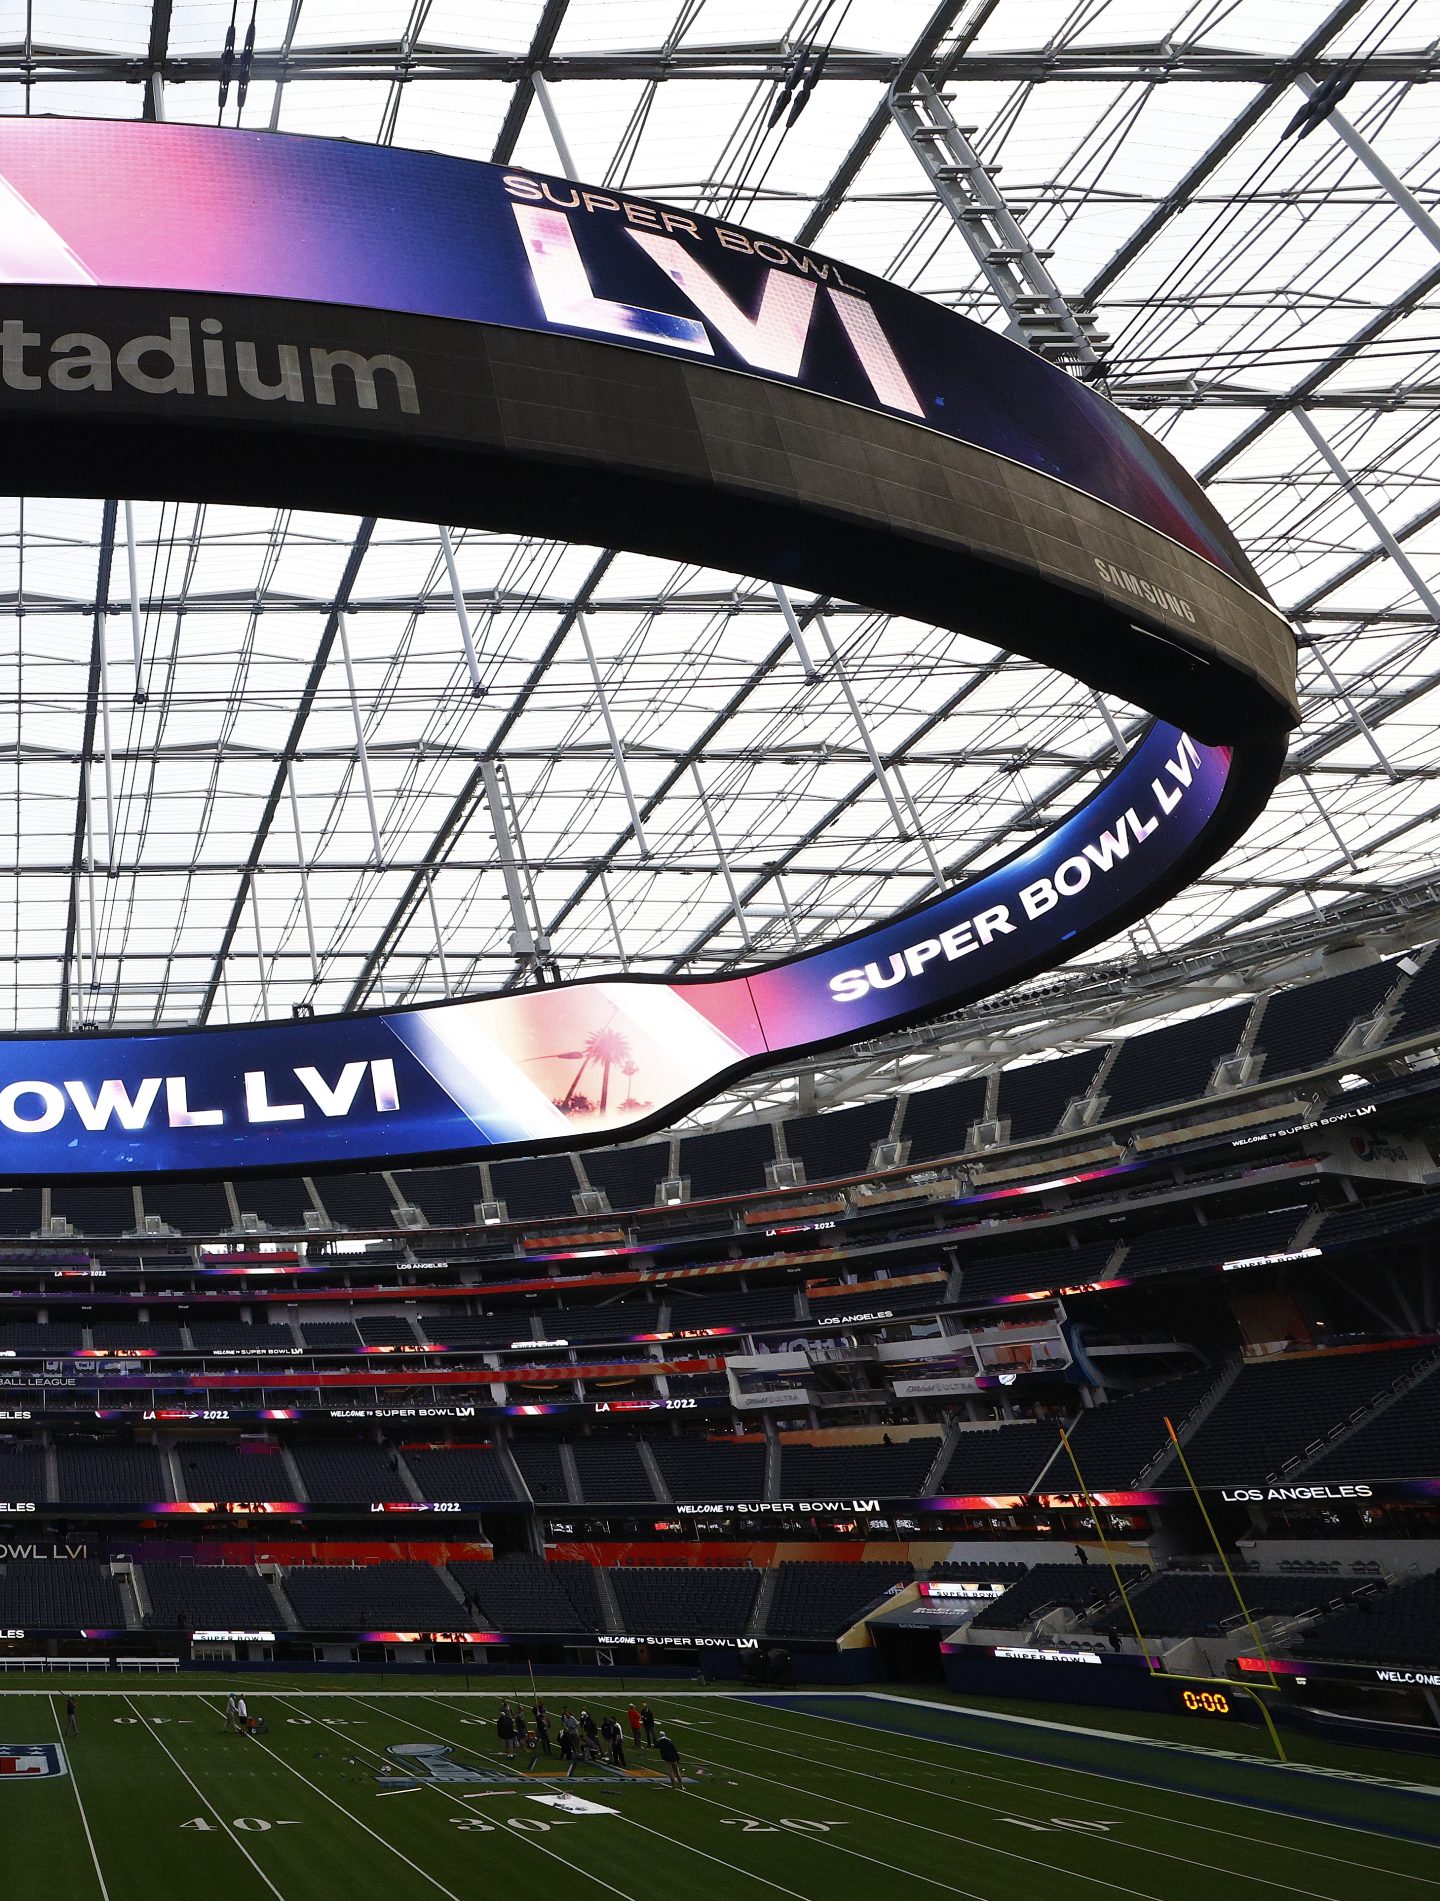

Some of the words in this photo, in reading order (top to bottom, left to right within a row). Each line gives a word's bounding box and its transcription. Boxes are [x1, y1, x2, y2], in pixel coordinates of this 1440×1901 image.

[503, 175, 703, 243] SUPER
[715, 229, 866, 295] BOWL
[512, 202, 926, 419] LVI
[1094, 557, 1196, 624] SAMSUNG
[829, 904, 1017, 1002] SUPER
[1019, 808, 1160, 920] BOWL
[1152, 731, 1201, 815] LVI
[244, 1058, 398, 1124] LVI
[1231, 1134, 1268, 1147] WELCOME
[1278, 1122, 1318, 1136] SUPER
[1321, 1112, 1356, 1125] BOWL
[1356, 1105, 1377, 1116] LVI
[814, 1222, 836, 1230] 2022
[818, 1317, 840, 1325] LOS
[841, 1311, 893, 1323] ANGELES
[28, 1378, 76, 1386] LEAGUE
[375, 1409, 416, 1417] SUPER
[418, 1408, 455, 1416] BOWL
[456, 1407, 475, 1417] LVI
[595, 1403, 611, 1413] LA
[666, 1399, 698, 1409] 2022
[143, 1411, 156, 1420] LA
[203, 1411, 230, 1419] 2022
[1222, 1489, 1264, 1502] LOS
[1267, 1485, 1373, 1500] ANGELES
[371, 1503, 385, 1512] LA
[433, 1503, 462, 1512] 2022
[677, 1504, 724, 1514] WELCOME
[737, 1502, 795, 1513] SUPER
[799, 1502, 851, 1512] BOWL
[852, 1500, 880, 1512] LVI
[53, 1544, 88, 1559] LVI
[598, 1636, 636, 1644] WELCOME
[646, 1636, 692, 1646] SUPER
[695, 1637, 736, 1647] BOWL
[736, 1638, 759, 1648] LVI
[1376, 1670, 1440, 1686] WELCOME
[1183, 1691, 1229, 1713] 0:00
[179, 1817, 272, 1831] 40
[448, 1817, 551, 1831] 30
[719, 1818, 831, 1831] 20
[991, 1817, 1111, 1831] 10
